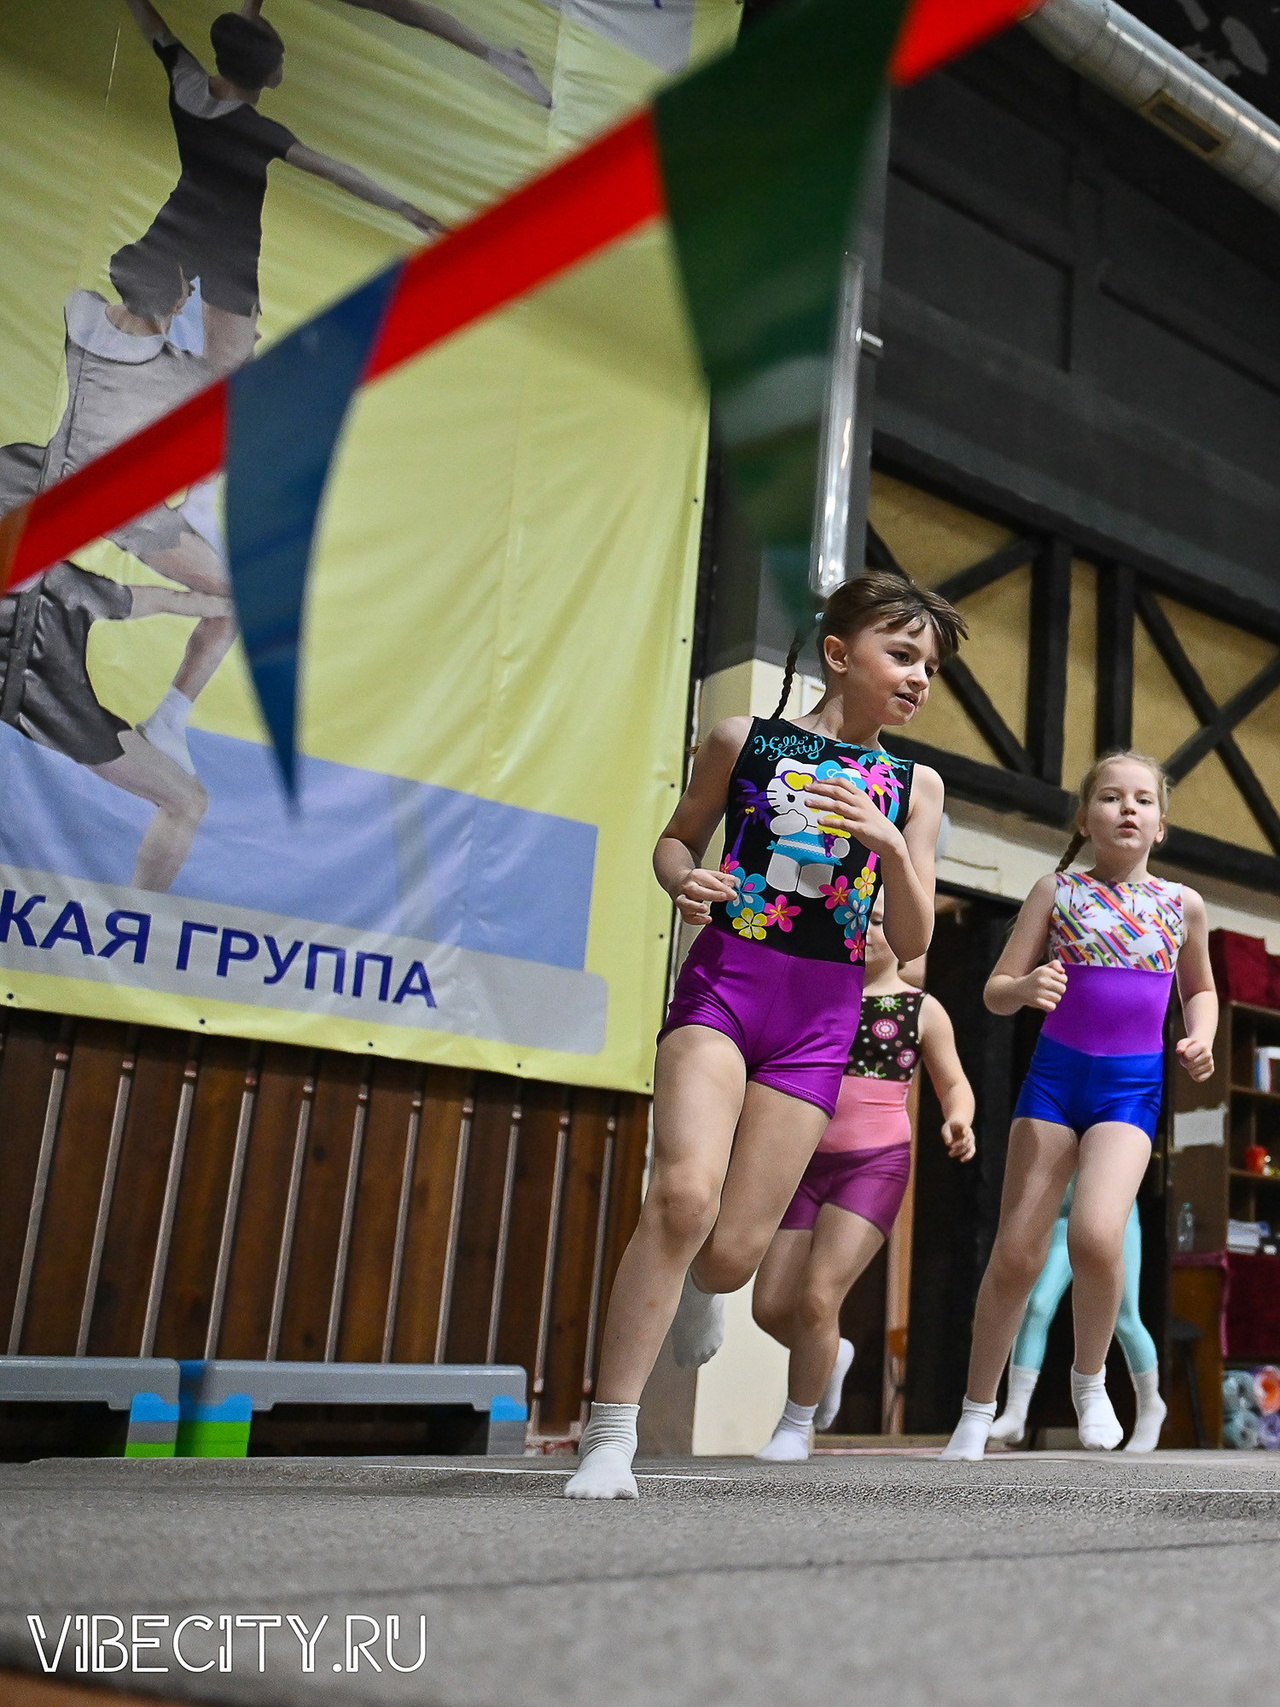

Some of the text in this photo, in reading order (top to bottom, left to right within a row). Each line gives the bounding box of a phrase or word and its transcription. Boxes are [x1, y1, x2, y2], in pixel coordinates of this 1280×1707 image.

[754, 734, 809, 755] Hello
[767, 734, 826, 761] Kitty
[0, 889, 438, 1010] КАЯ ГРУППА
